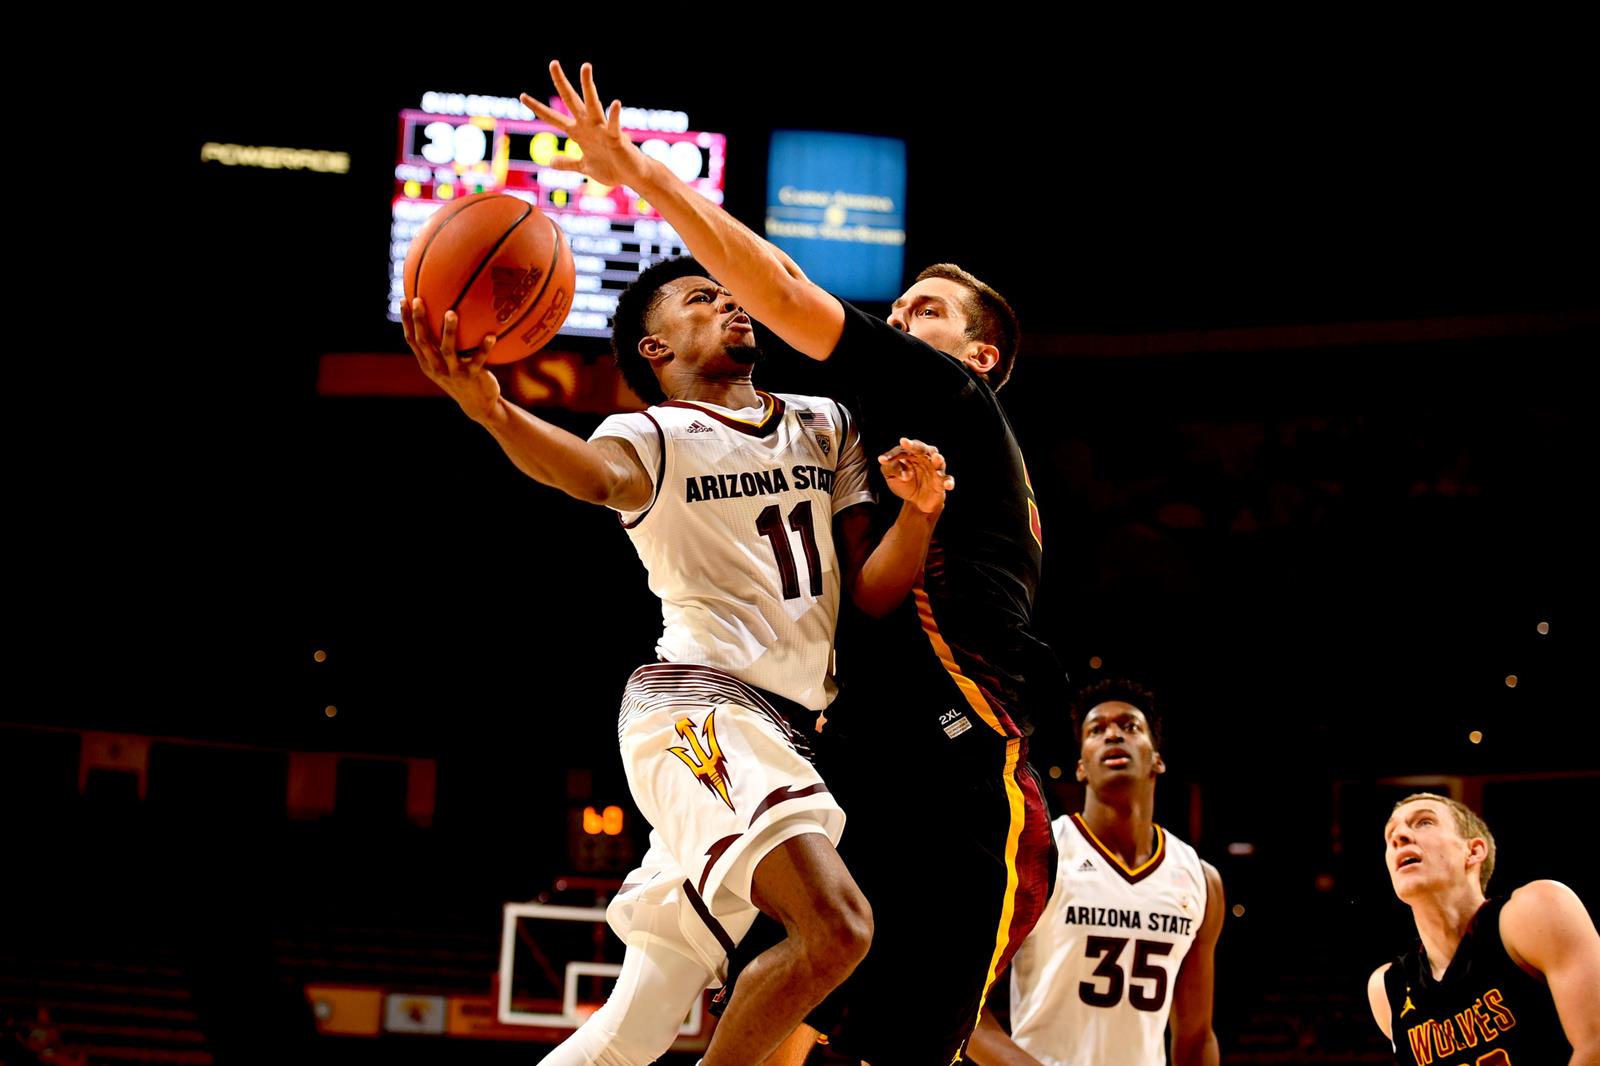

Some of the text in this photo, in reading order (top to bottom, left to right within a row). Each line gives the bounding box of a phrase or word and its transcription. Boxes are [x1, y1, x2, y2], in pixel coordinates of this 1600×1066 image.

[686, 467, 790, 504] ARIZONA
[755, 500, 823, 601] 11
[938, 708, 962, 726] 2XL
[1065, 905, 1193, 936] ARIZONA STATE
[1078, 934, 1175, 1013] 35
